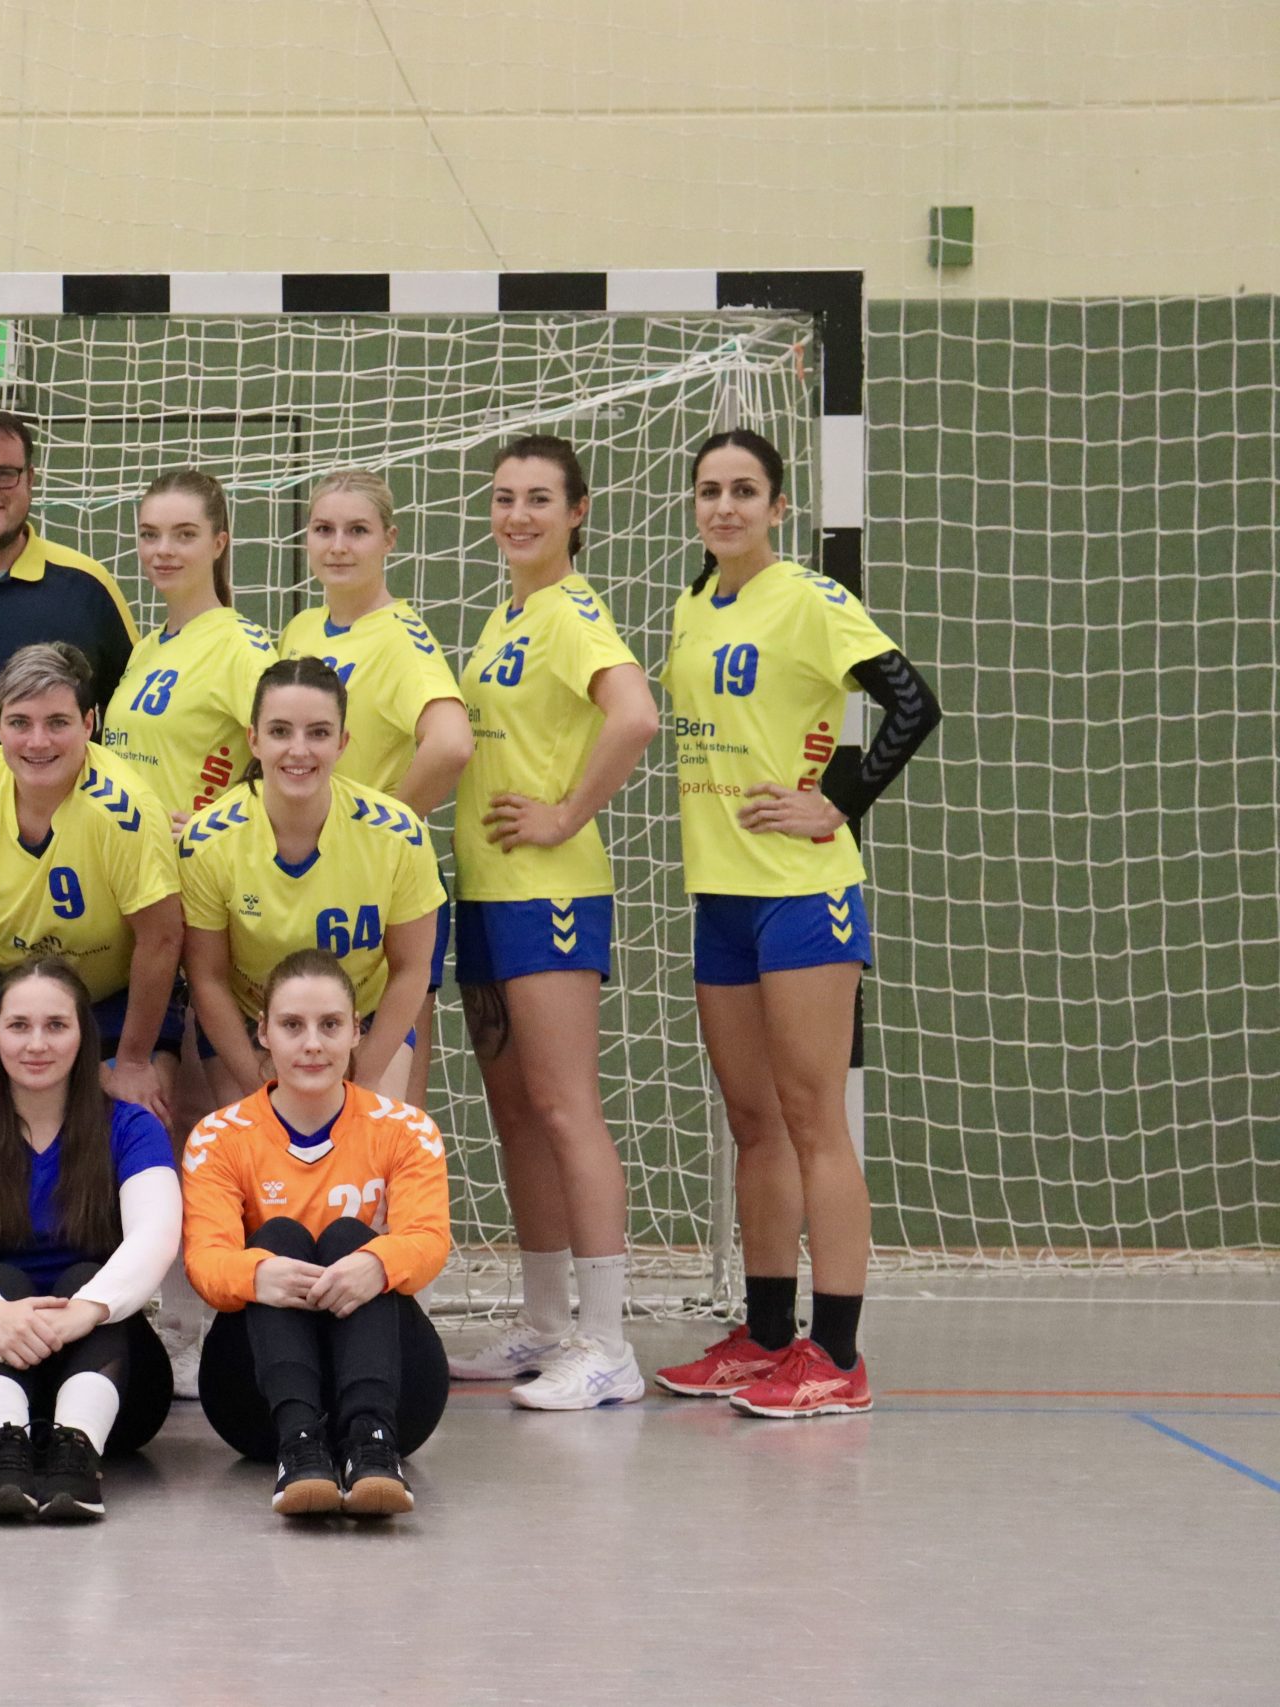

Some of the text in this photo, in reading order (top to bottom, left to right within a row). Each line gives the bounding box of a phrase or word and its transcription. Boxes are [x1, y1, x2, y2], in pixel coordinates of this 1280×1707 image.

[479, 636, 530, 687] 25
[712, 643, 759, 697] 19
[130, 669, 179, 716] 13
[48, 867, 85, 919] 9
[316, 904, 382, 960] 64
